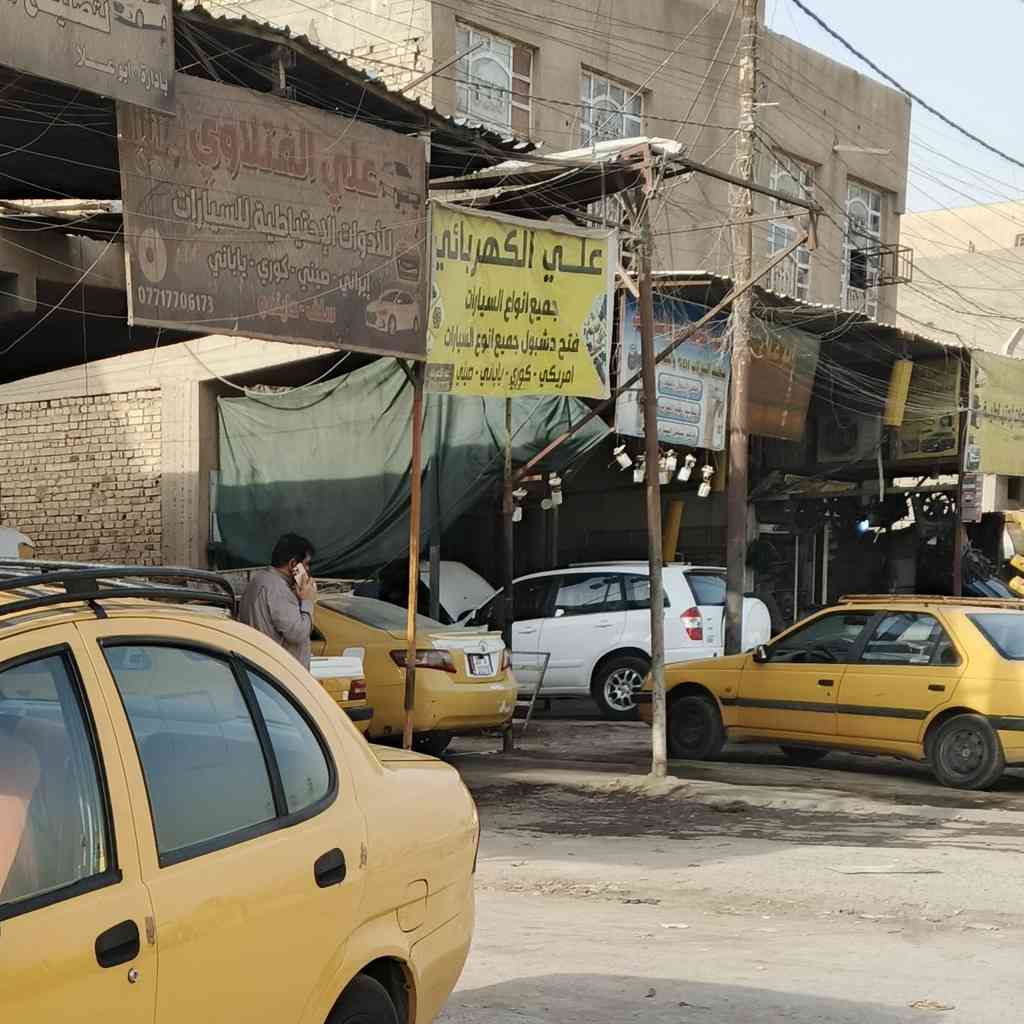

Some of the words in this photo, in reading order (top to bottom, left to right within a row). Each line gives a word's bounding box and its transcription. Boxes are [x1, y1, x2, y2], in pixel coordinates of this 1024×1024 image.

[435, 220, 536, 276] الكهربائي
[542, 236, 603, 283] علي
[256, 255, 289, 287] كوري
[465, 286, 504, 318] السيارات
[504, 289, 529, 322] انواع
[528, 295, 560, 325] جميع
[444, 326, 474, 353] السيارات
[494, 333, 520, 358] جميع
[510, 363, 531, 390] كوري
[539, 364, 574, 388] امريكي
